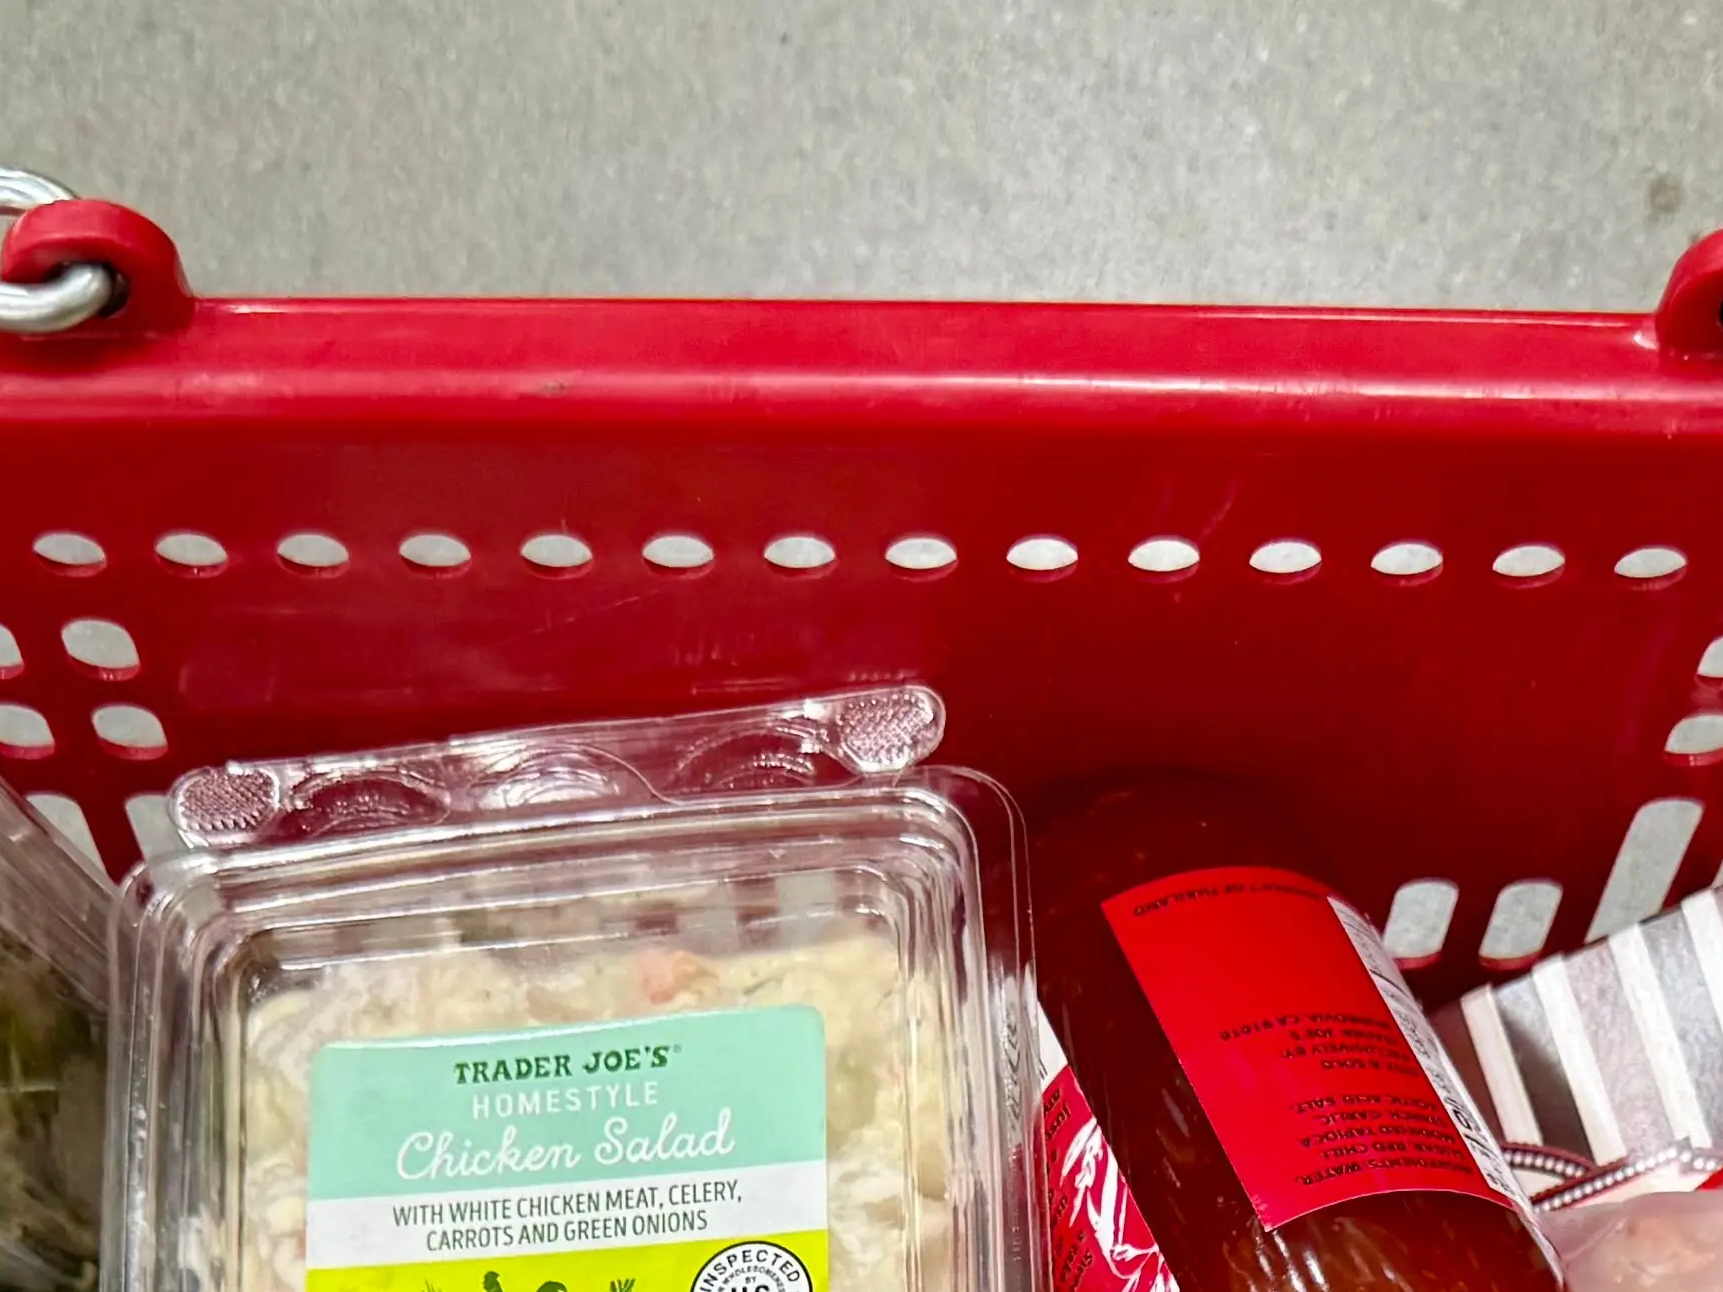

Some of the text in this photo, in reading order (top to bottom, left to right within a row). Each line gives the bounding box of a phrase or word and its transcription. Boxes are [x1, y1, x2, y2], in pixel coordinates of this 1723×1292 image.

[454, 1045, 670, 1085] TRADER JOE'S
[472, 1081, 659, 1121] HOMESTYLE
[396, 1107, 736, 1180] Chicken Salad
[393, 1180, 743, 1227] WITH WHITE CHICKEN MEAT, CELERY,
[426, 1210, 708, 1252] CARROTS AND GREEN ONIONS
[699, 1249, 801, 1292] INSPECTED
